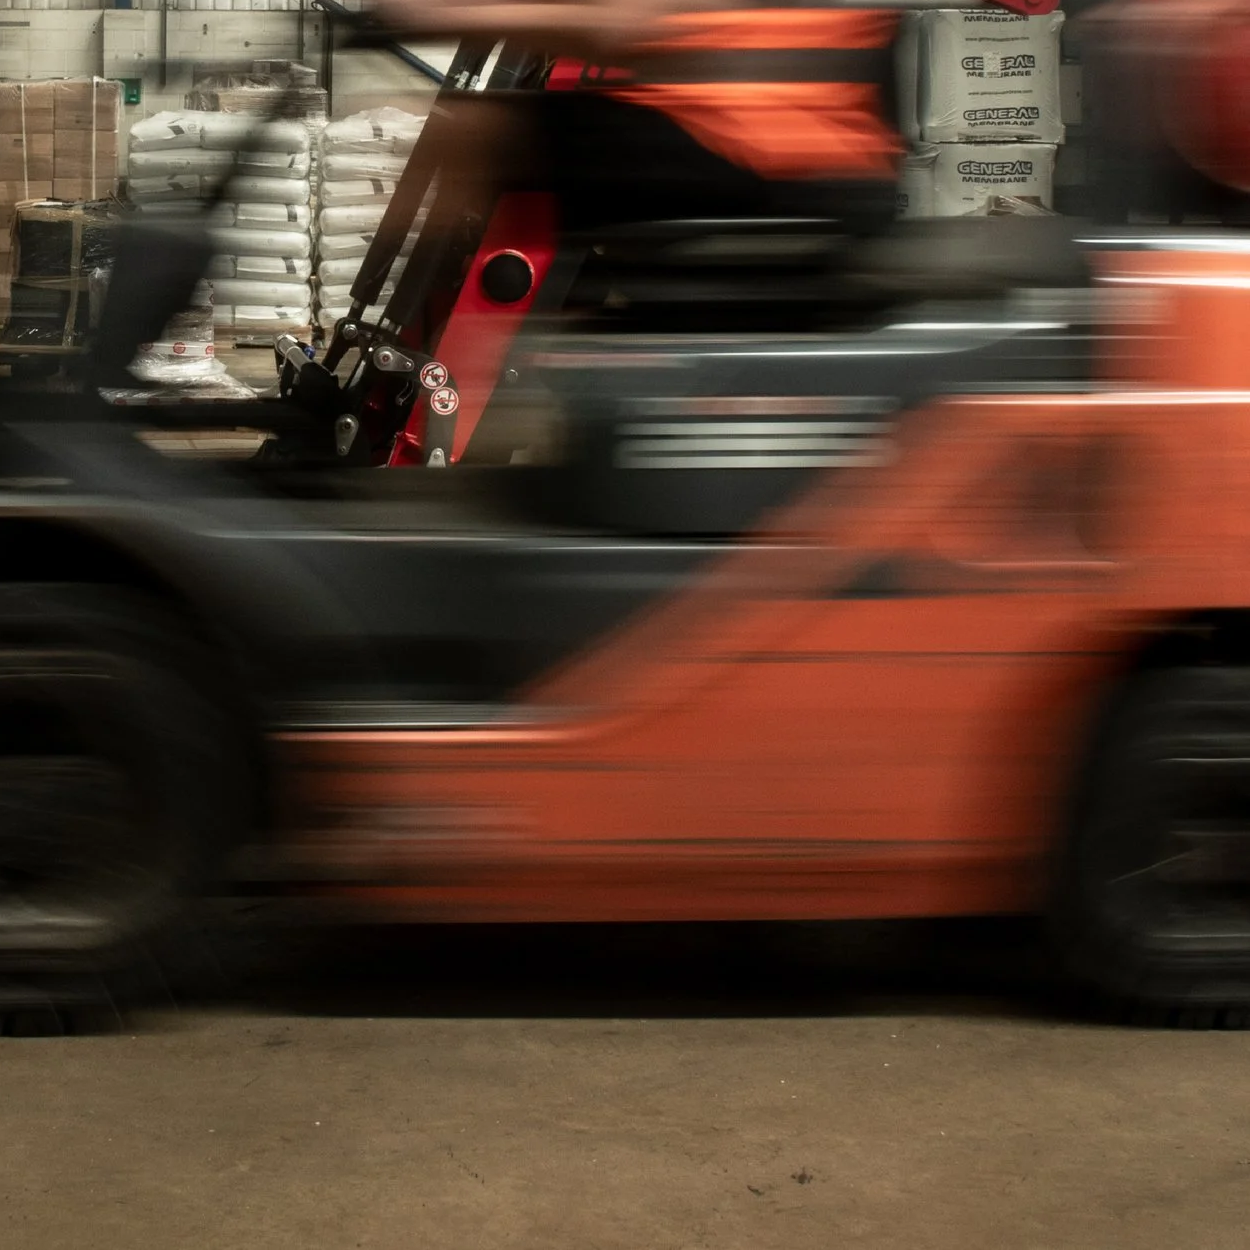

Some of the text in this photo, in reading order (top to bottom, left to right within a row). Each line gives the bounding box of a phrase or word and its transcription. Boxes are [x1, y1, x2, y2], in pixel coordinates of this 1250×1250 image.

[963, 15, 1030, 23] MEMBRANE
[961, 54, 1036, 70] GEERAL
[962, 106, 1040, 121] GENERAL
[957, 160, 1033, 175] GENERAL
[961, 176, 1028, 184] MEMBRANE
